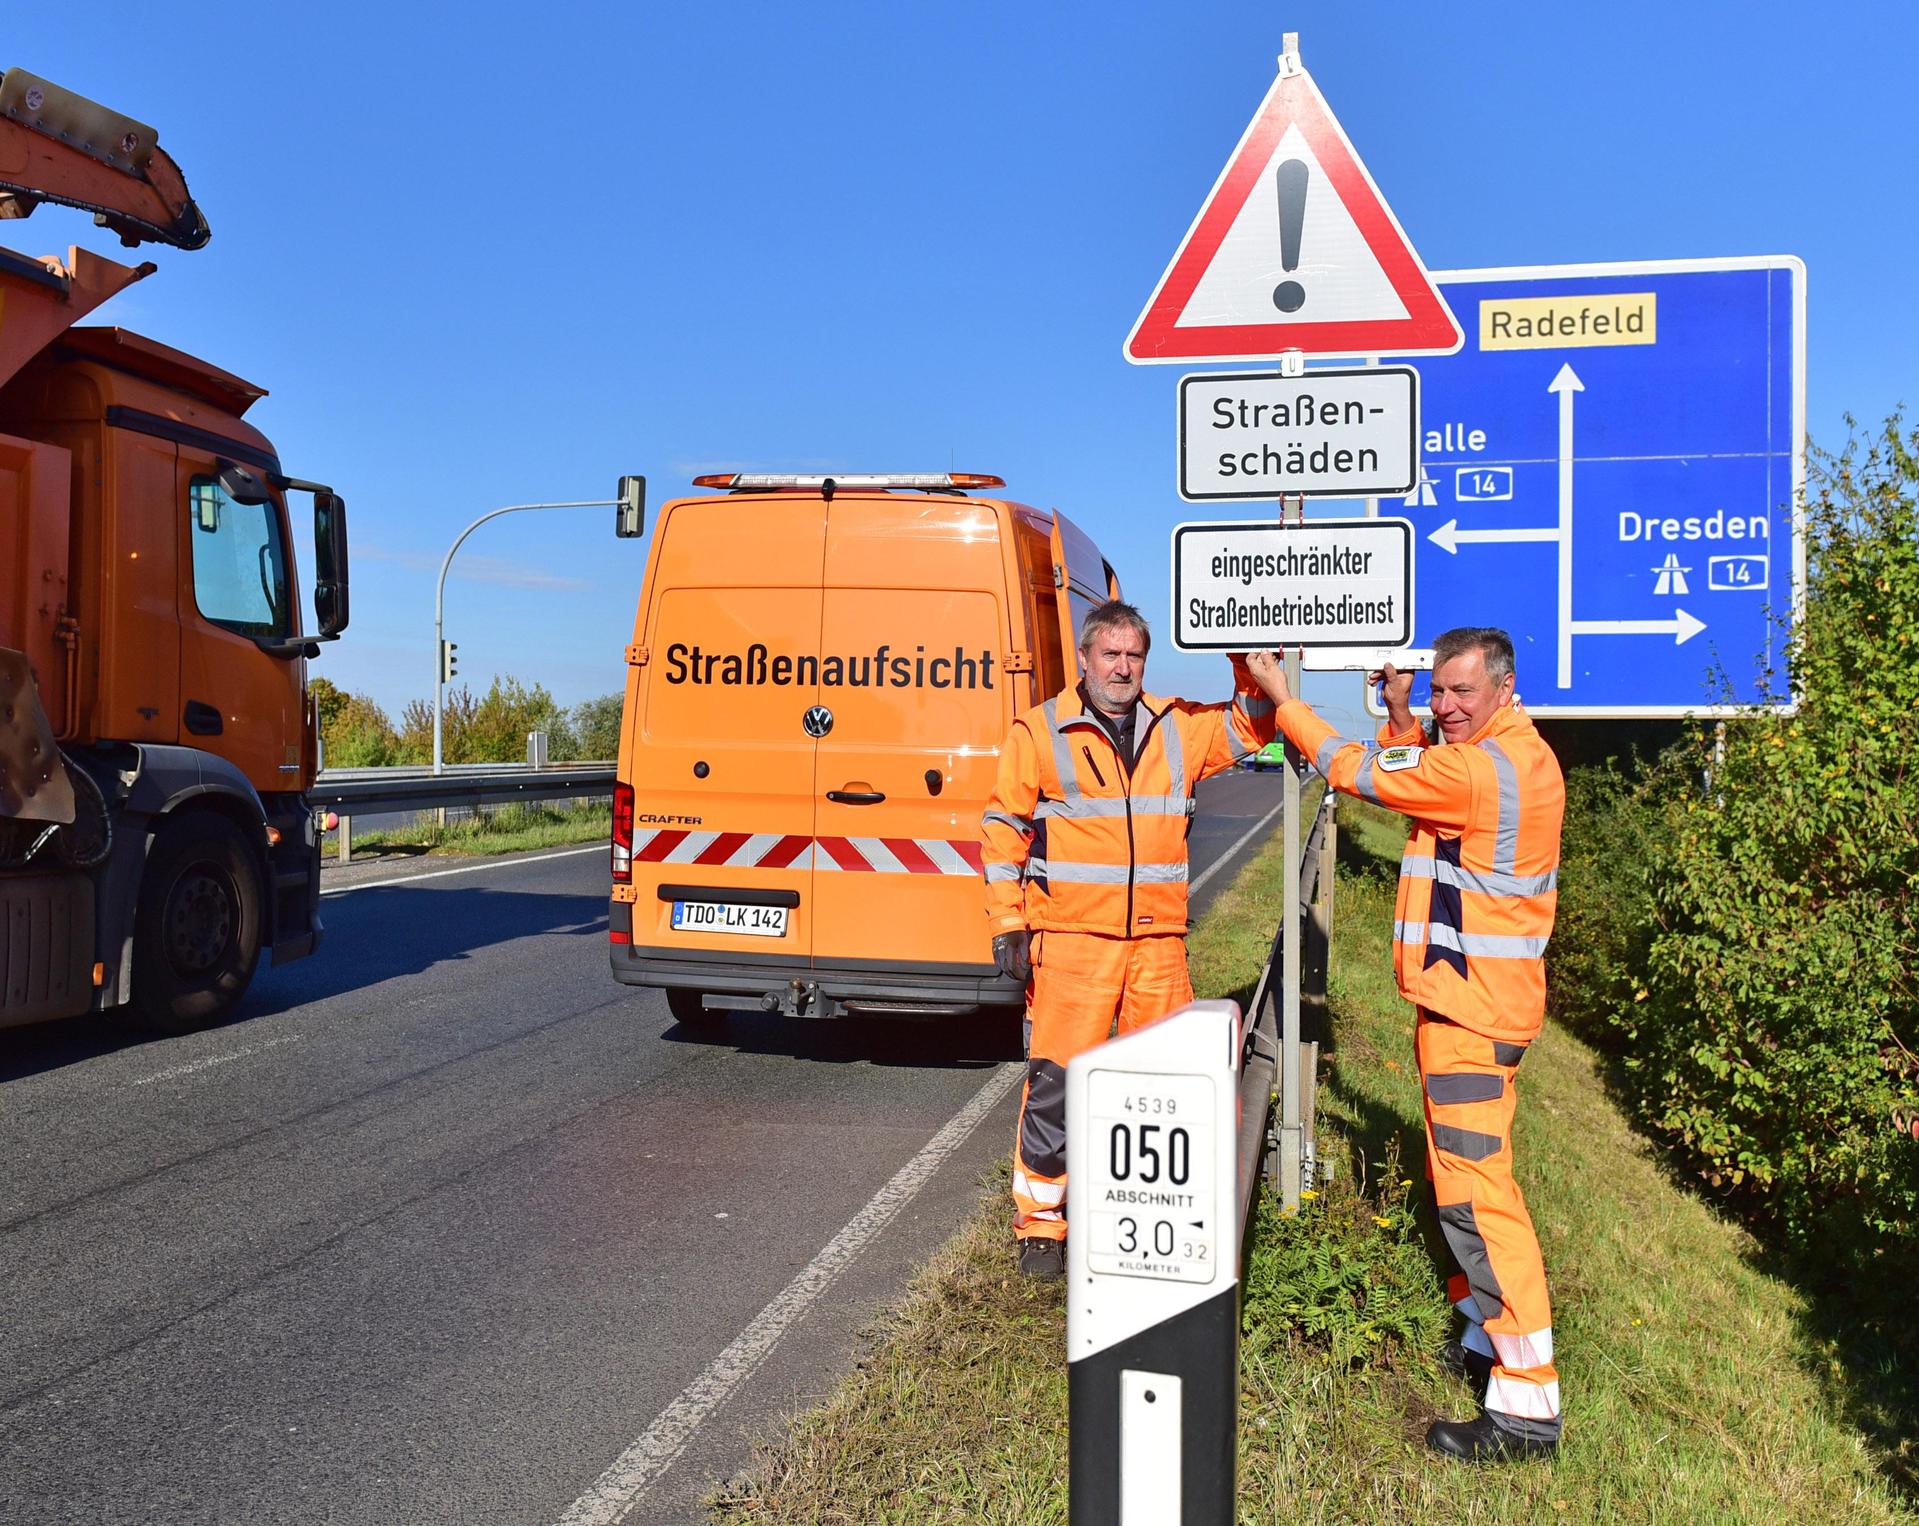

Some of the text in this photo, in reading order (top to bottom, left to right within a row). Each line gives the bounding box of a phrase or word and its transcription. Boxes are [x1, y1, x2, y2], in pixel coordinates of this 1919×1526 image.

[1491, 305, 1643, 338] Radefeld
[1212, 394, 1384, 429] Straßen-
[1420, 422, 1487, 452] alle
[1218, 441, 1378, 476] schäden
[1473, 474, 1496, 494] 14
[1619, 509, 1768, 541] Dresden
[1211, 545, 1372, 585] eingeschränkter
[1726, 562, 1750, 583] 14
[1189, 594, 1394, 628] Straßenbetriebsdienst
[665, 643, 994, 690] Straßenaufsicht
[639, 814, 702, 825] CRAFTER
[685, 904, 783, 929] TDO LK 142
[1124, 1096, 1177, 1115] 4539
[1110, 1123, 1189, 1186] 050
[1105, 1189, 1195, 1208] ABSCHNITT
[1184, 1242, 1208, 1261] 32
[1118, 1261, 1181, 1274] KILOMETER
